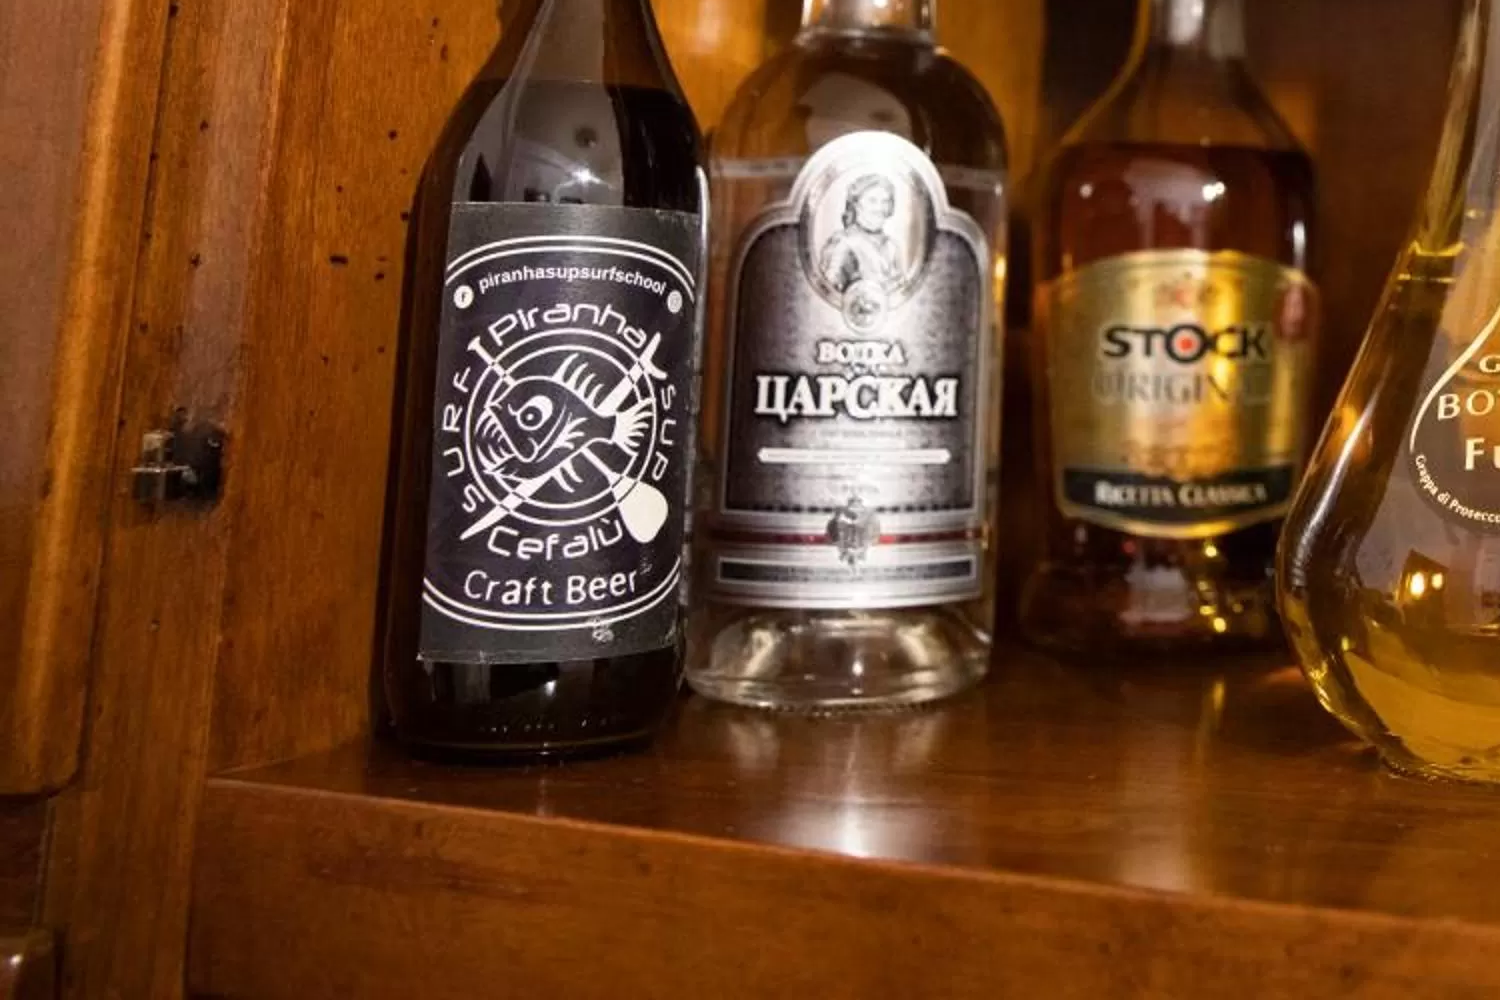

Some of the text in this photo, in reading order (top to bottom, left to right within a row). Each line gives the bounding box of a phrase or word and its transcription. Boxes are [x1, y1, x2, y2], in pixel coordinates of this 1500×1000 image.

[479, 265, 667, 297] piranhasupsurfschool
[487, 302, 650, 350] Piranha
[1103, 324, 1267, 364] STOCK
[753, 373, 958, 424] ЦАРСКАЯ
[441, 366, 486, 514] SURF
[1415, 453, 1439, 496] Grappa
[1437, 490, 1451, 506] di
[486, 517, 625, 562] Cefalù
[463, 568, 638, 606] Craft Beer
